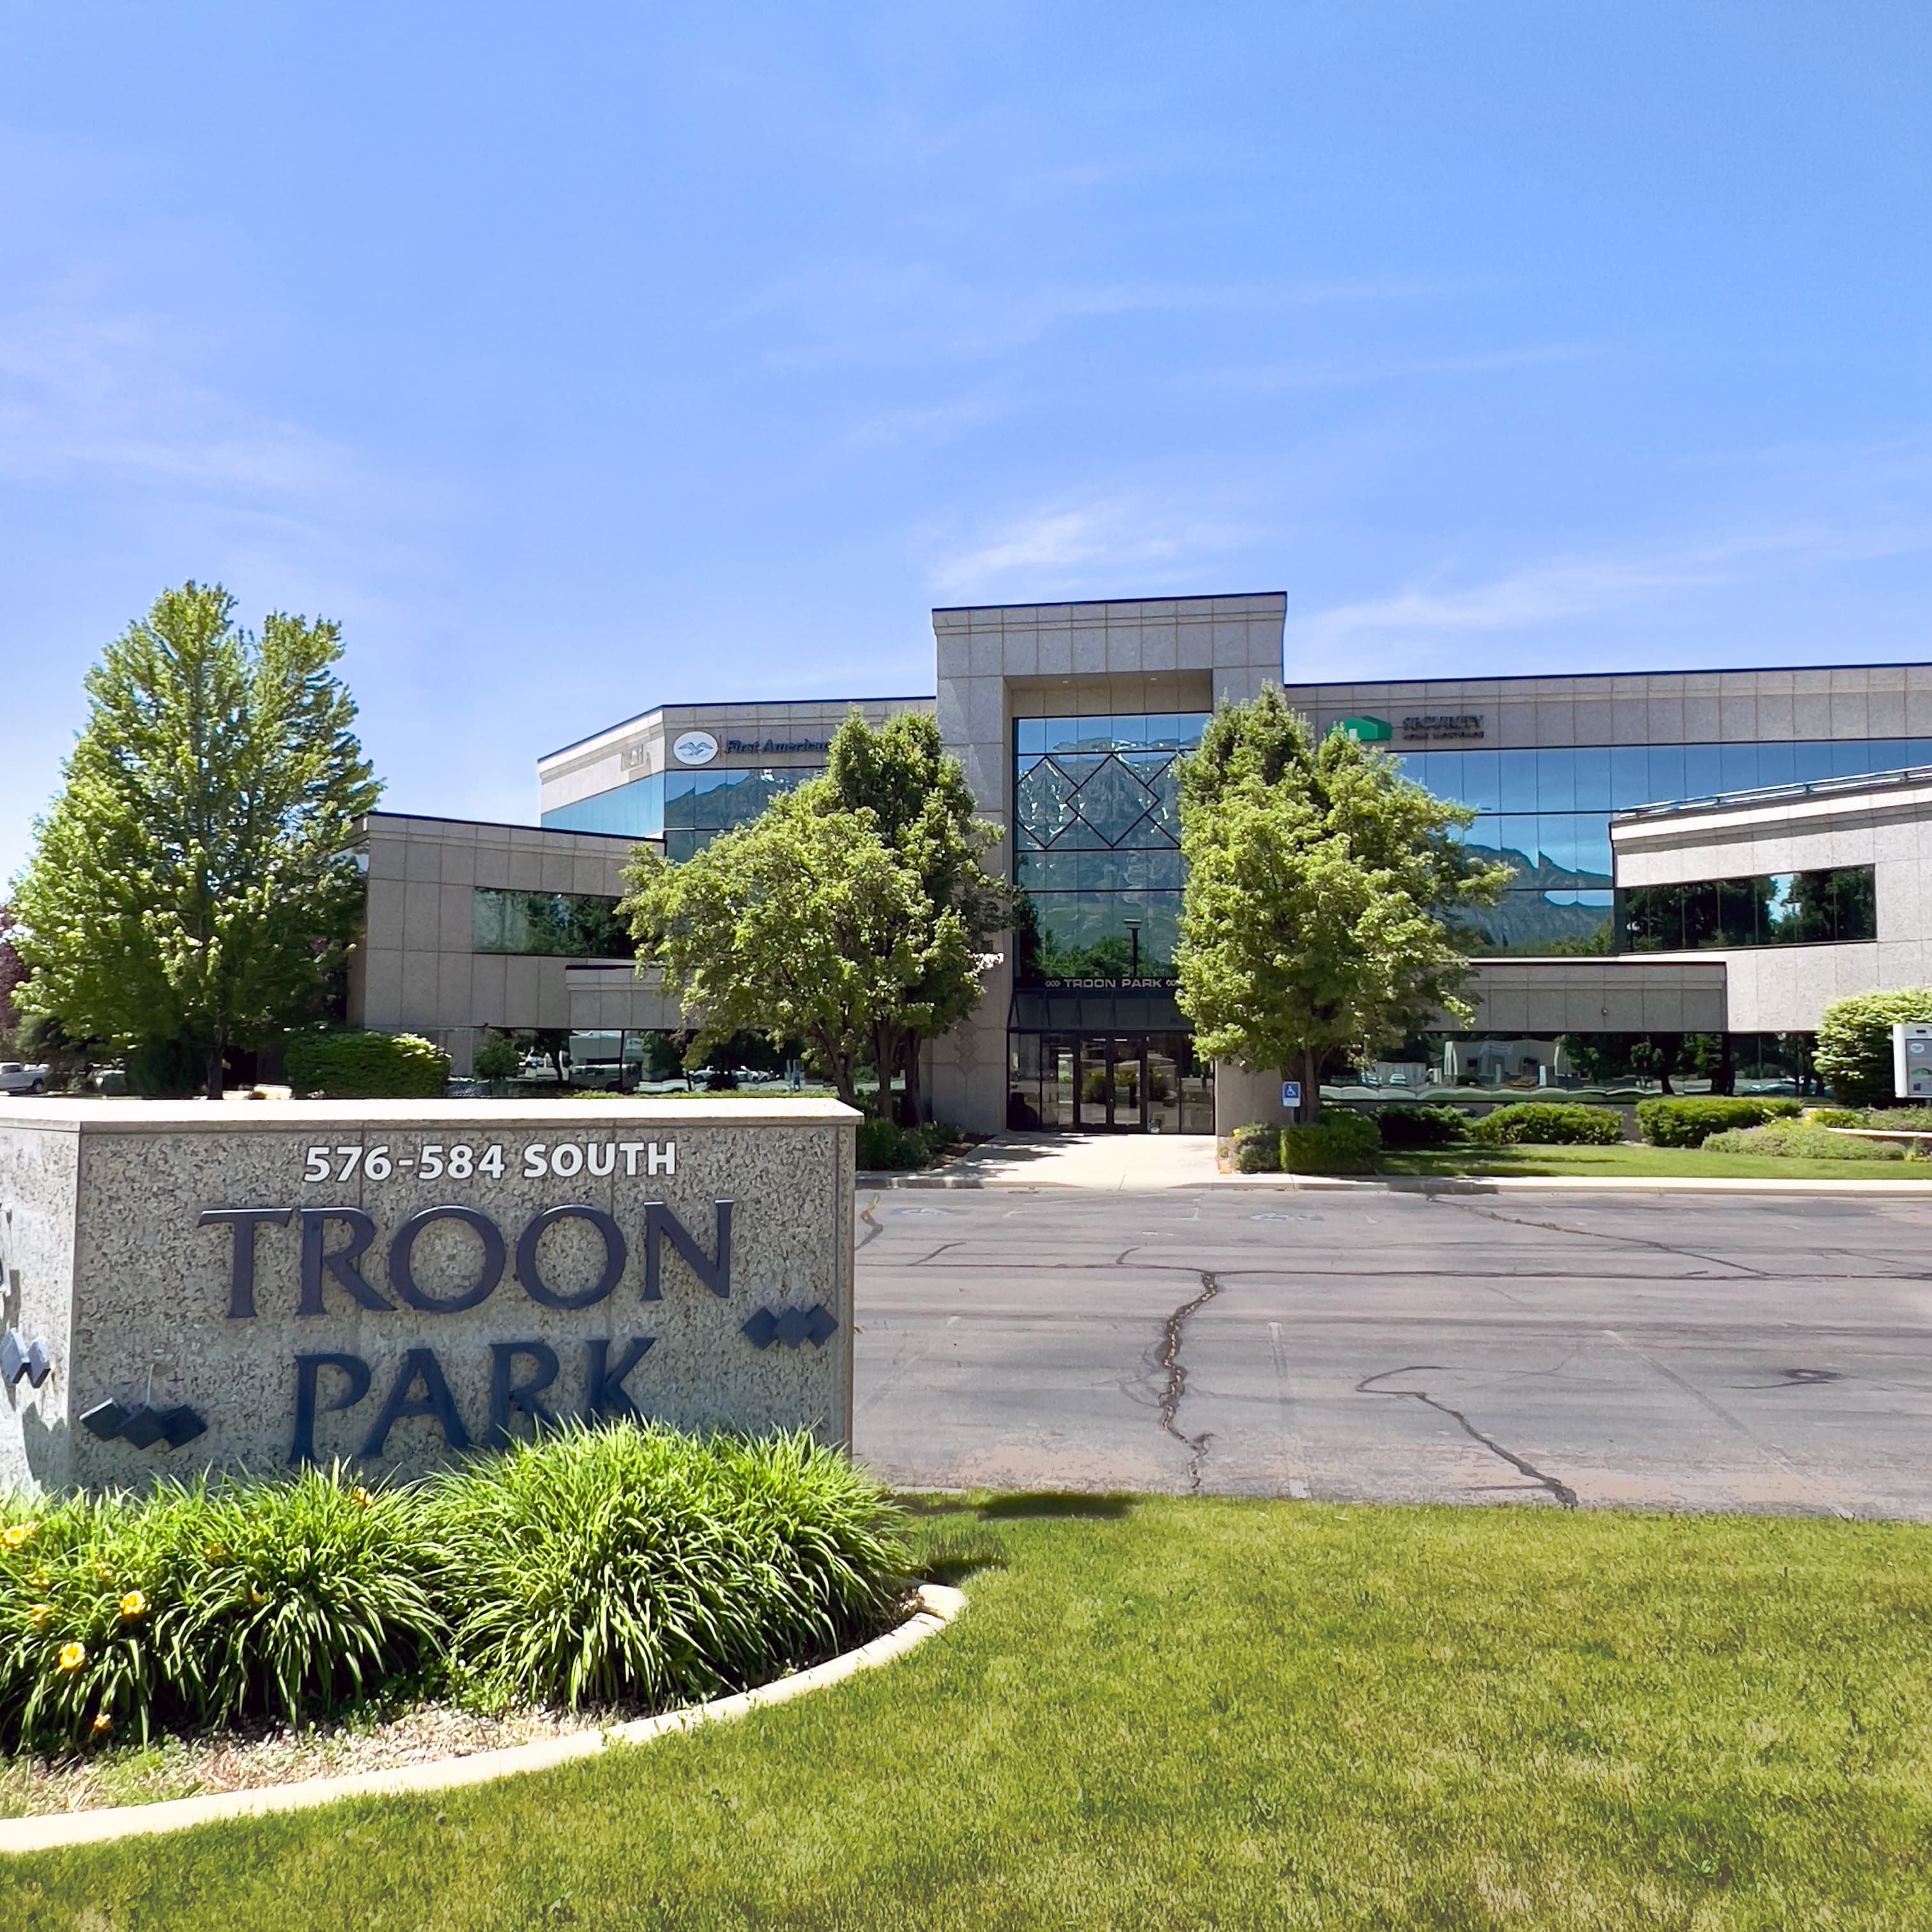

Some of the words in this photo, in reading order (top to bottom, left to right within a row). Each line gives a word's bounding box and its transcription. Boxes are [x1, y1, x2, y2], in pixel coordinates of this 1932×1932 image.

[725, 739, 760, 754] First
[1064, 978, 1116, 988] TROON
[1121, 978, 1162, 988] PARK
[302, 1145, 506, 1183] 576-584
[522, 1141, 677, 1179] SOUTH
[197, 1199, 735, 1318] TROON
[287, 1337, 657, 1466] PARK
